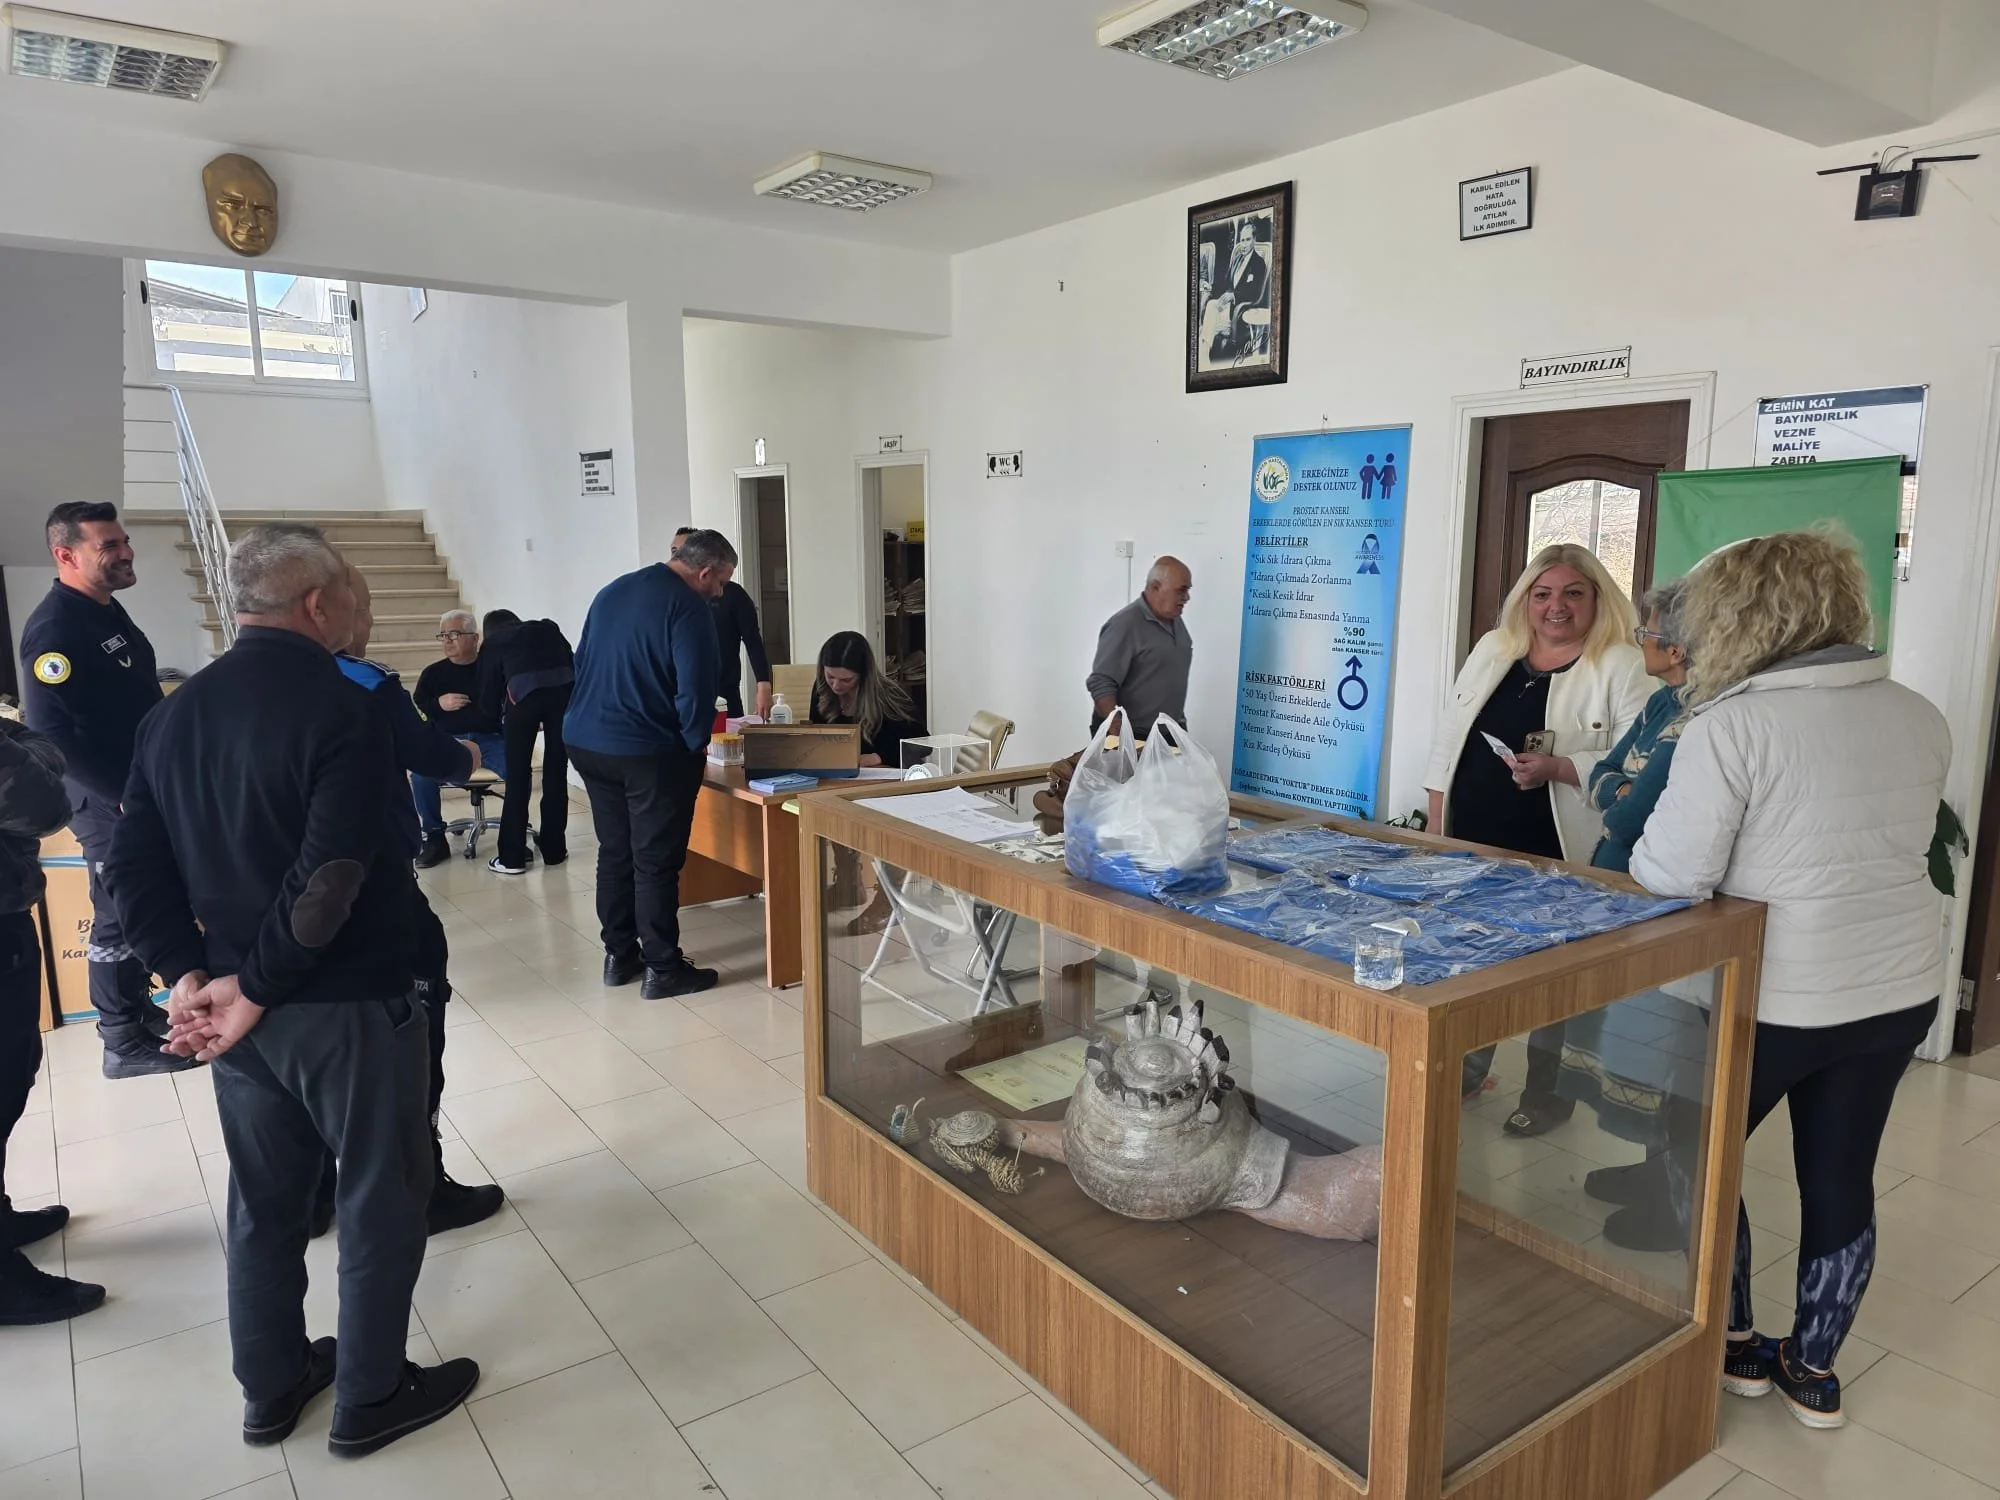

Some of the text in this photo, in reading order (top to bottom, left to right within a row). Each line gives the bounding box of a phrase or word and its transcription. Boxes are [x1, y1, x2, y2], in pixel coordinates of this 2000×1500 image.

[1470, 178, 1520, 194] KABUL EDİLEN
[1486, 192, 1504, 200] HATA
[1474, 199, 1516, 212] DOĞRULUĞA
[1482, 210, 1507, 220] ATILAN
[1473, 218, 1517, 232] İLK ADIMDIR.
[1524, 356, 1628, 379] BAYINDIRLIK
[1764, 397, 1836, 412] ZEMİN KAT
[1775, 410, 1858, 425] BAYINDIRLIK
[1774, 427, 1816, 438] VEZNE
[1772, 439, 1821, 452] MALİYE
[999, 457, 1010, 467] WC
[1771, 455, 1817, 465] ZABITA
[1301, 467, 1349, 479] ERKEĞİNİZE
[1293, 481, 1357, 492] DESTEK OLUNUZ
[1293, 506, 1350, 515] PROSTAT KANSERİ
[1323, 518, 1334, 527] EN
[1345, 518, 1373, 528] KANSER
[1255, 535, 1309, 547] BELİRTİLER
[1305, 555, 1332, 567] Çıkma
[1275, 572, 1309, 584] Çıkmada
[1311, 573, 1352, 586] Zorlanma
[1273, 590, 1294, 600] Kesik
[1273, 607, 1298, 620] Çıkma
[1299, 609, 1340, 622] Esnasında
[1342, 612, 1370, 624] Yanma
[1344, 627, 1365, 637] %90
[1345, 647, 1370, 655] KANSER
[1245, 671, 1326, 691] RİSK FAKTÖRLERİ
[1269, 690, 1287, 703] Üzeri
[1289, 694, 1331, 709] Erkeklerde
[1270, 710, 1311, 725] Kanserinde
[1313, 716, 1330, 727] Aile
[1333, 717, 1365, 732] Öyküsü
[1267, 726, 1293, 739] Kanseri
[1295, 731, 1316, 743] Anne
[1318, 734, 1338, 748] Veya
[1257, 741, 1281, 755] Kardeş
[1282, 745, 1311, 760] Öyküsü
[1311, 784, 1334, 795] DEMEK
[1292, 793, 1323, 806] KONTROL
